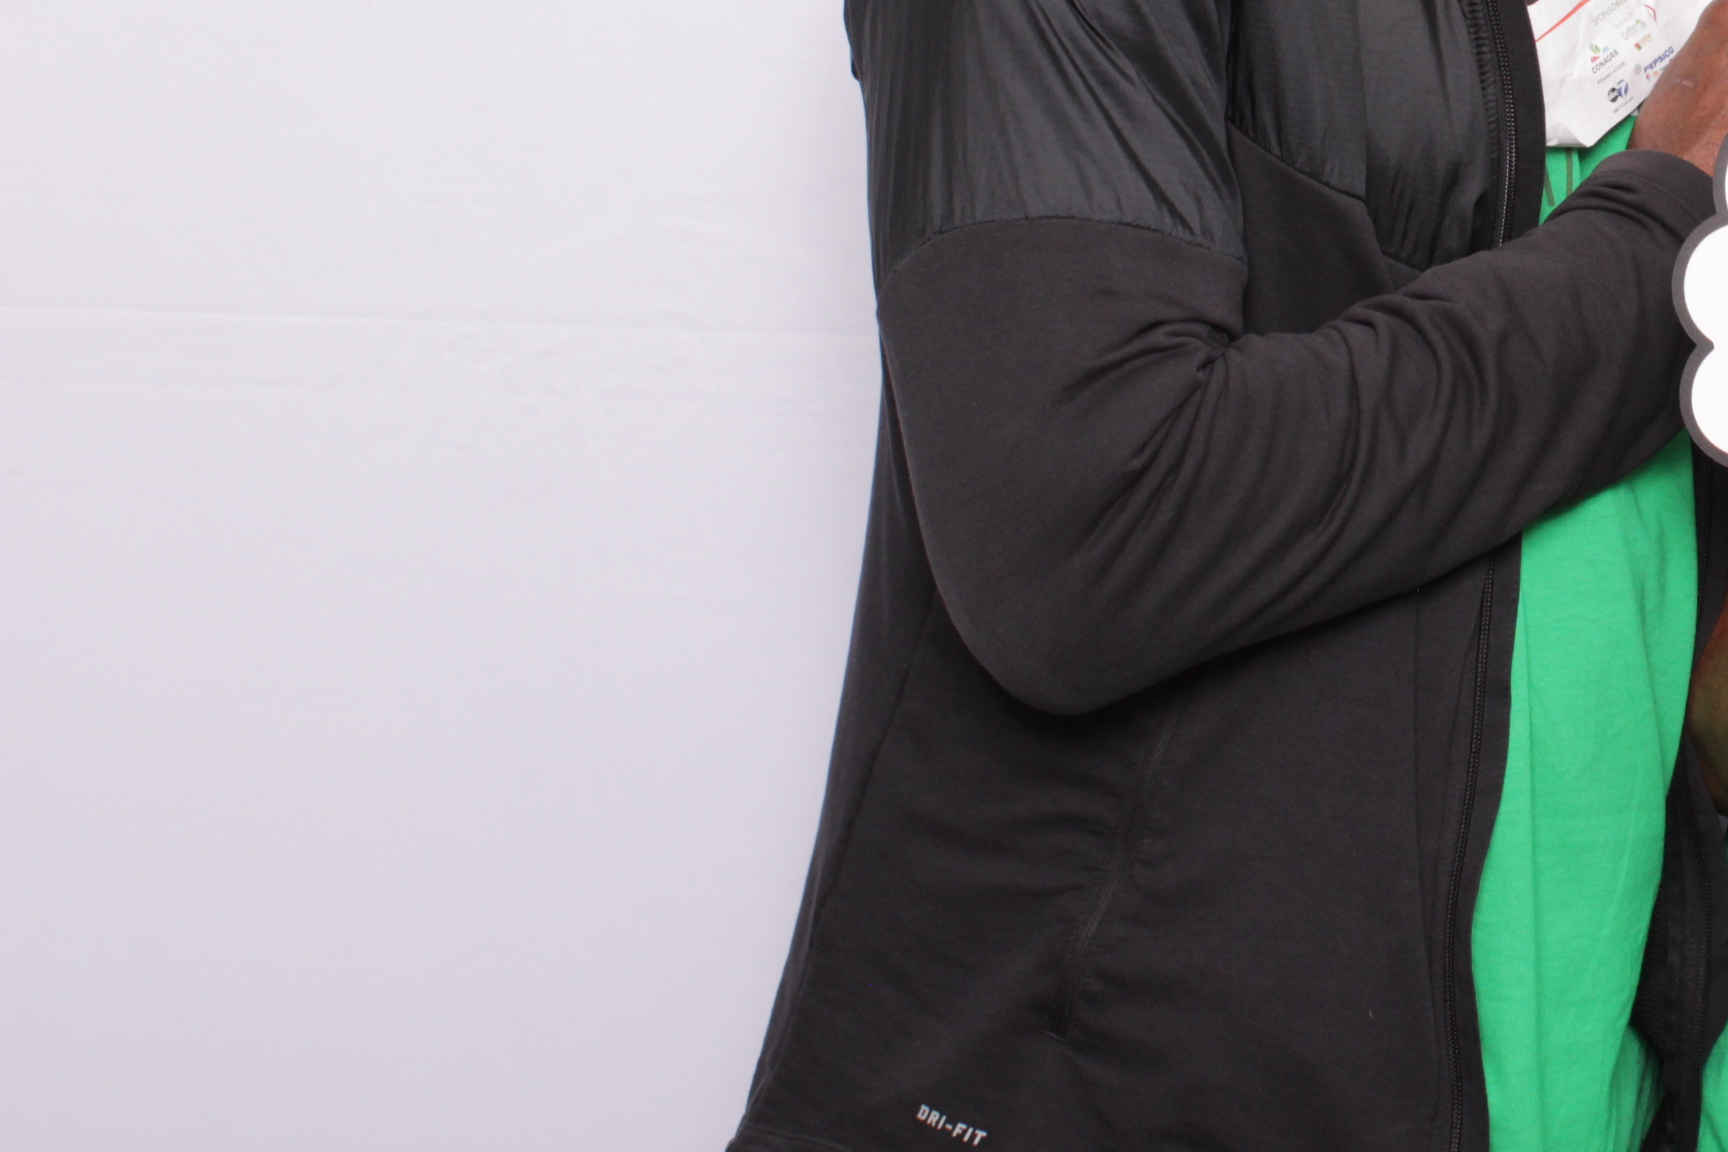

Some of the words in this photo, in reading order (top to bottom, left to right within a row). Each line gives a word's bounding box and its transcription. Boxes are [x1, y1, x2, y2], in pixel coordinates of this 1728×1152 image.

[1591, 49, 1620, 74] CONAGRA
[1643, 46, 1675, 73] PEPSICO
[916, 1103, 988, 1146] DRI-FIT
